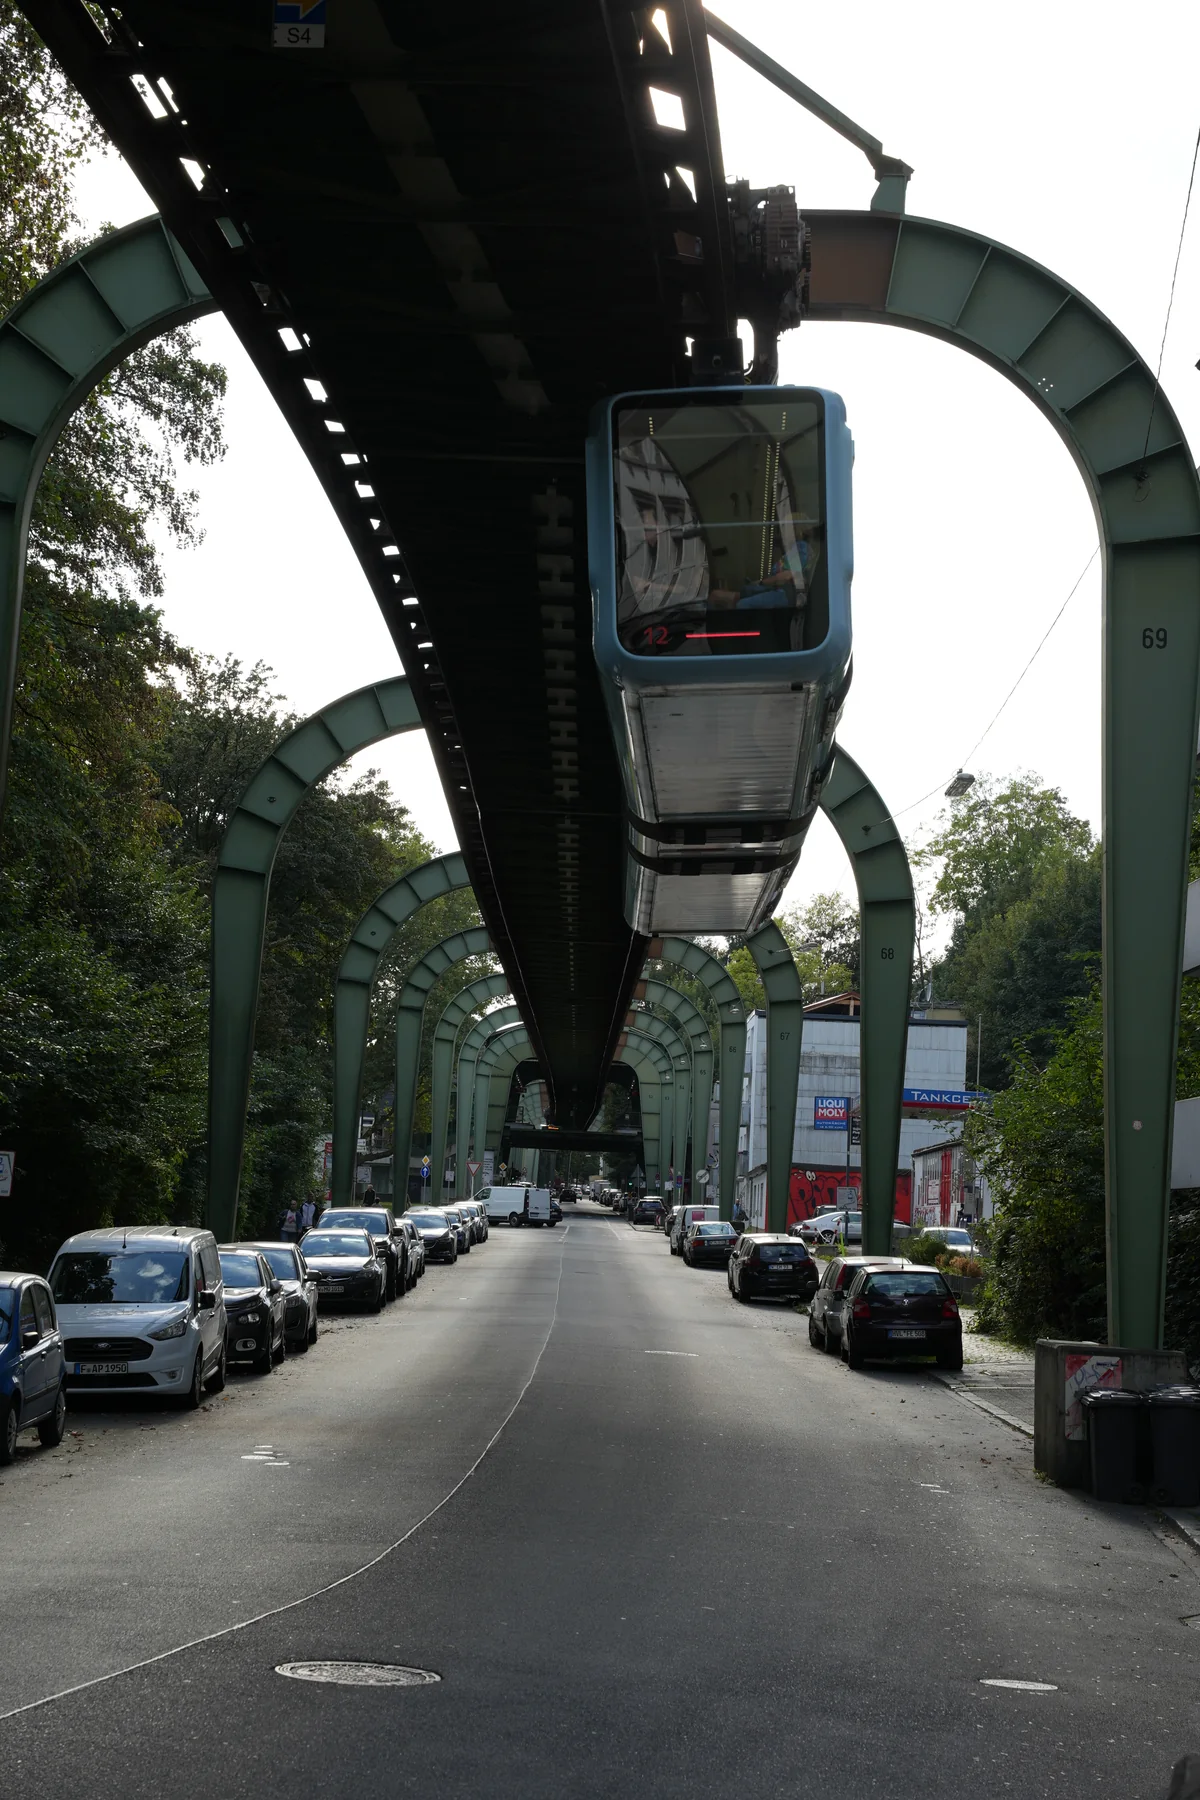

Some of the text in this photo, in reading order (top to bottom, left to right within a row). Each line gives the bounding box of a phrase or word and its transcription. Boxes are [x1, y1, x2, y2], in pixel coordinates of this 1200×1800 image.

[287, 27, 311, 44] S4
[643, 626, 669, 645] 12
[1142, 627, 1168, 649] 69
[880, 947, 895, 960] 68
[780, 1032, 790, 1041] 67
[818, 1099, 845, 1108] LIQUI
[911, 1091, 972, 1104] TANKCE
[818, 1108, 845, 1117] MOLY
[105, 1363, 127, 1373] 1950
